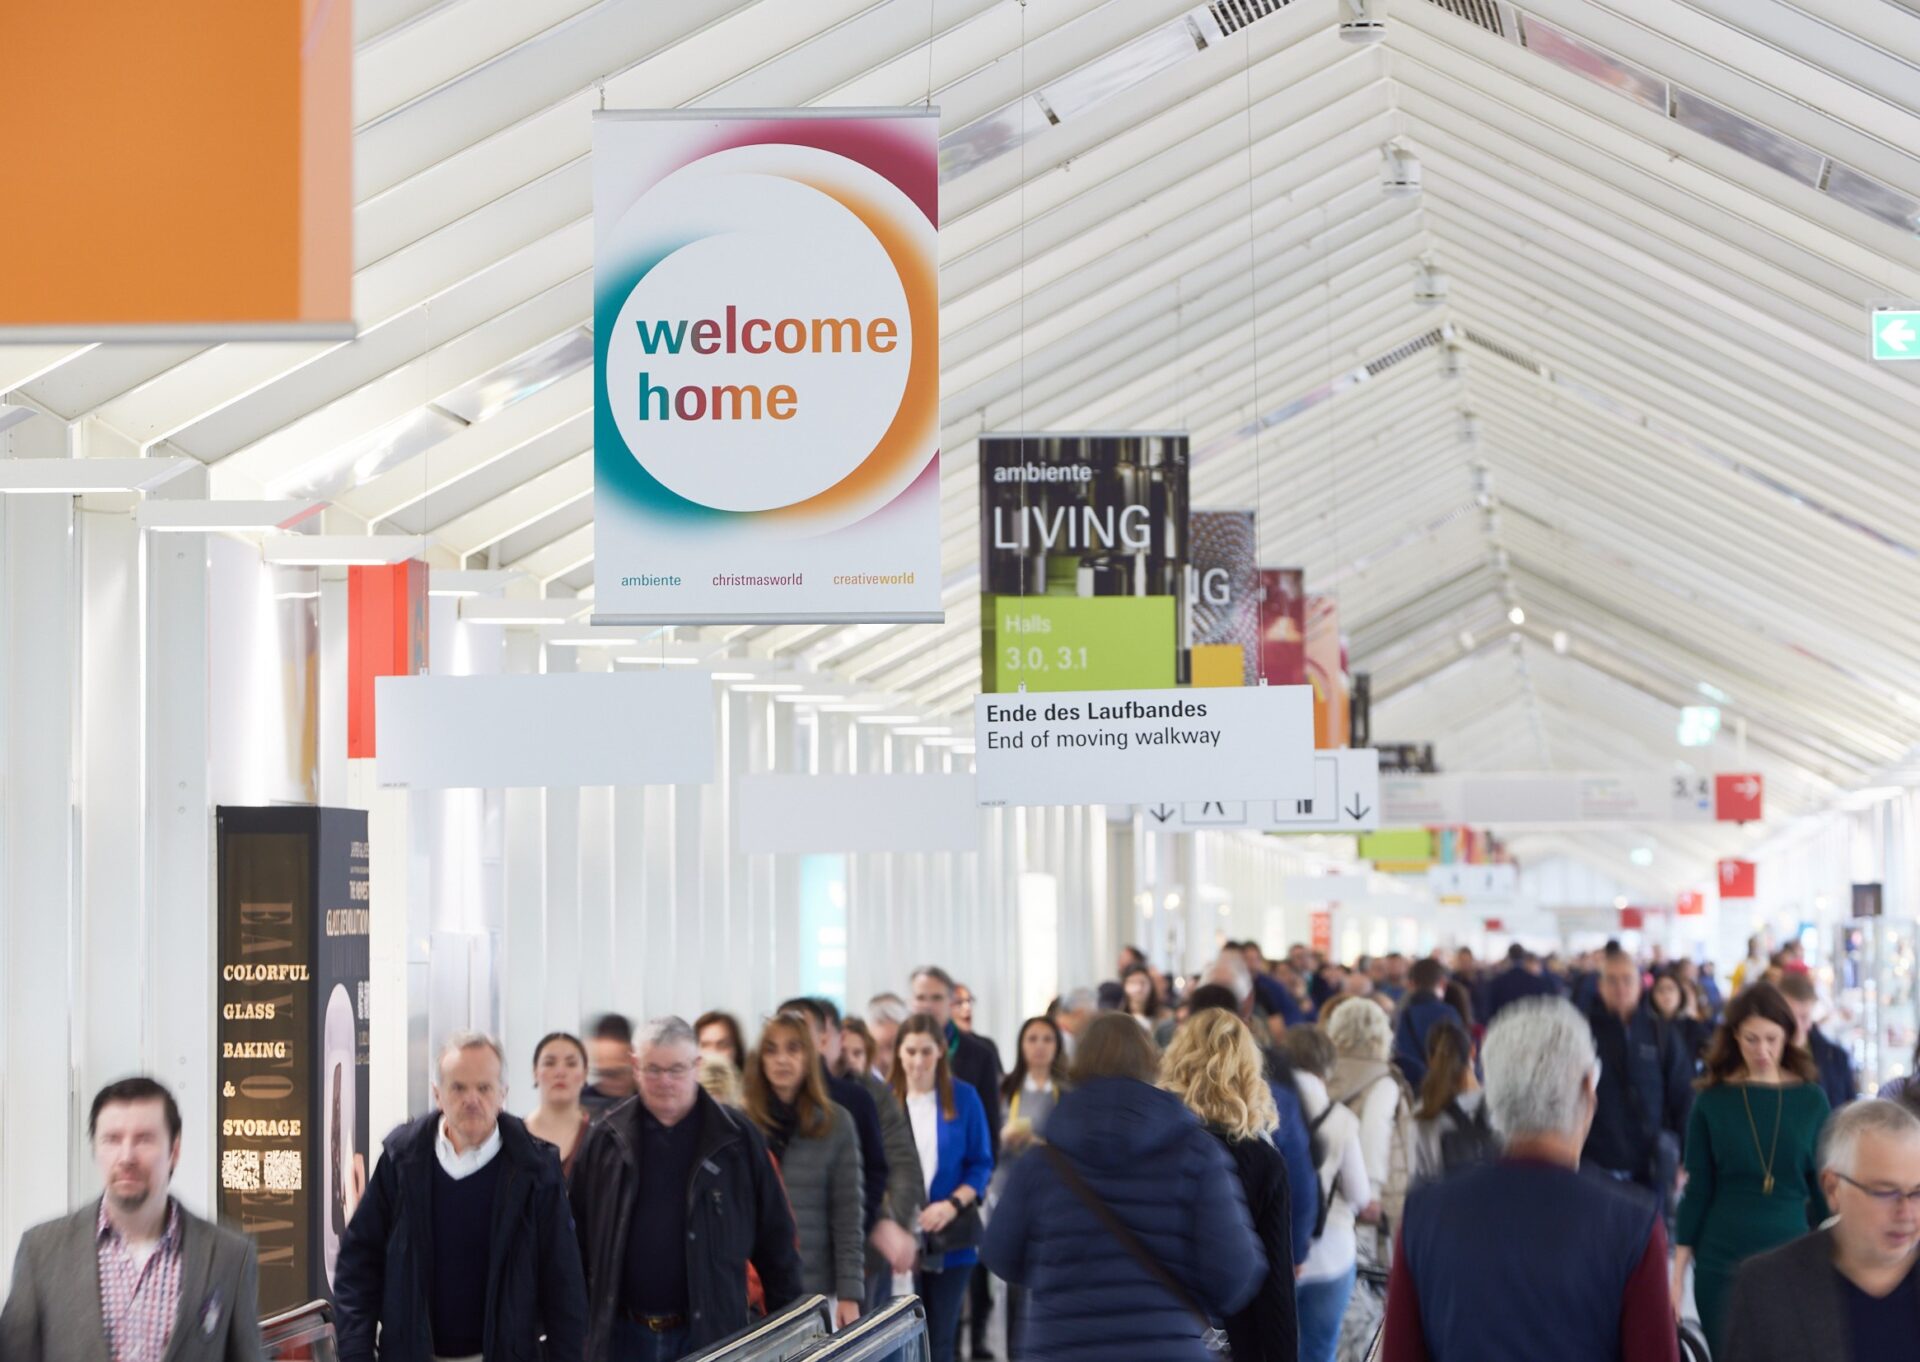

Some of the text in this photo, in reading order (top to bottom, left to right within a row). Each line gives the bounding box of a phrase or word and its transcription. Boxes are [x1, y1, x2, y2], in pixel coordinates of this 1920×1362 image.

[636, 305, 898, 355] welcome
[638, 372, 798, 421] home
[994, 462, 1093, 483] ambiente
[994, 505, 1150, 549] LIVING
[621, 574, 682, 587] ambiente
[712, 573, 803, 586] christmasworld
[833, 572, 915, 585] creativeworld
[1005, 615, 1051, 633] Halls
[1007, 646, 1088, 672] 3.0, 3.1
[987, 700, 1207, 722] Ende des Laufbandes
[988, 727, 1221, 750] End of moving walkway
[223, 965, 309, 981] COLORFUL
[223, 1004, 275, 1020] GLASS
[223, 1042, 286, 1059] BAKING
[223, 1081, 236, 1097] &
[223, 1119, 301, 1136] STORAGE
